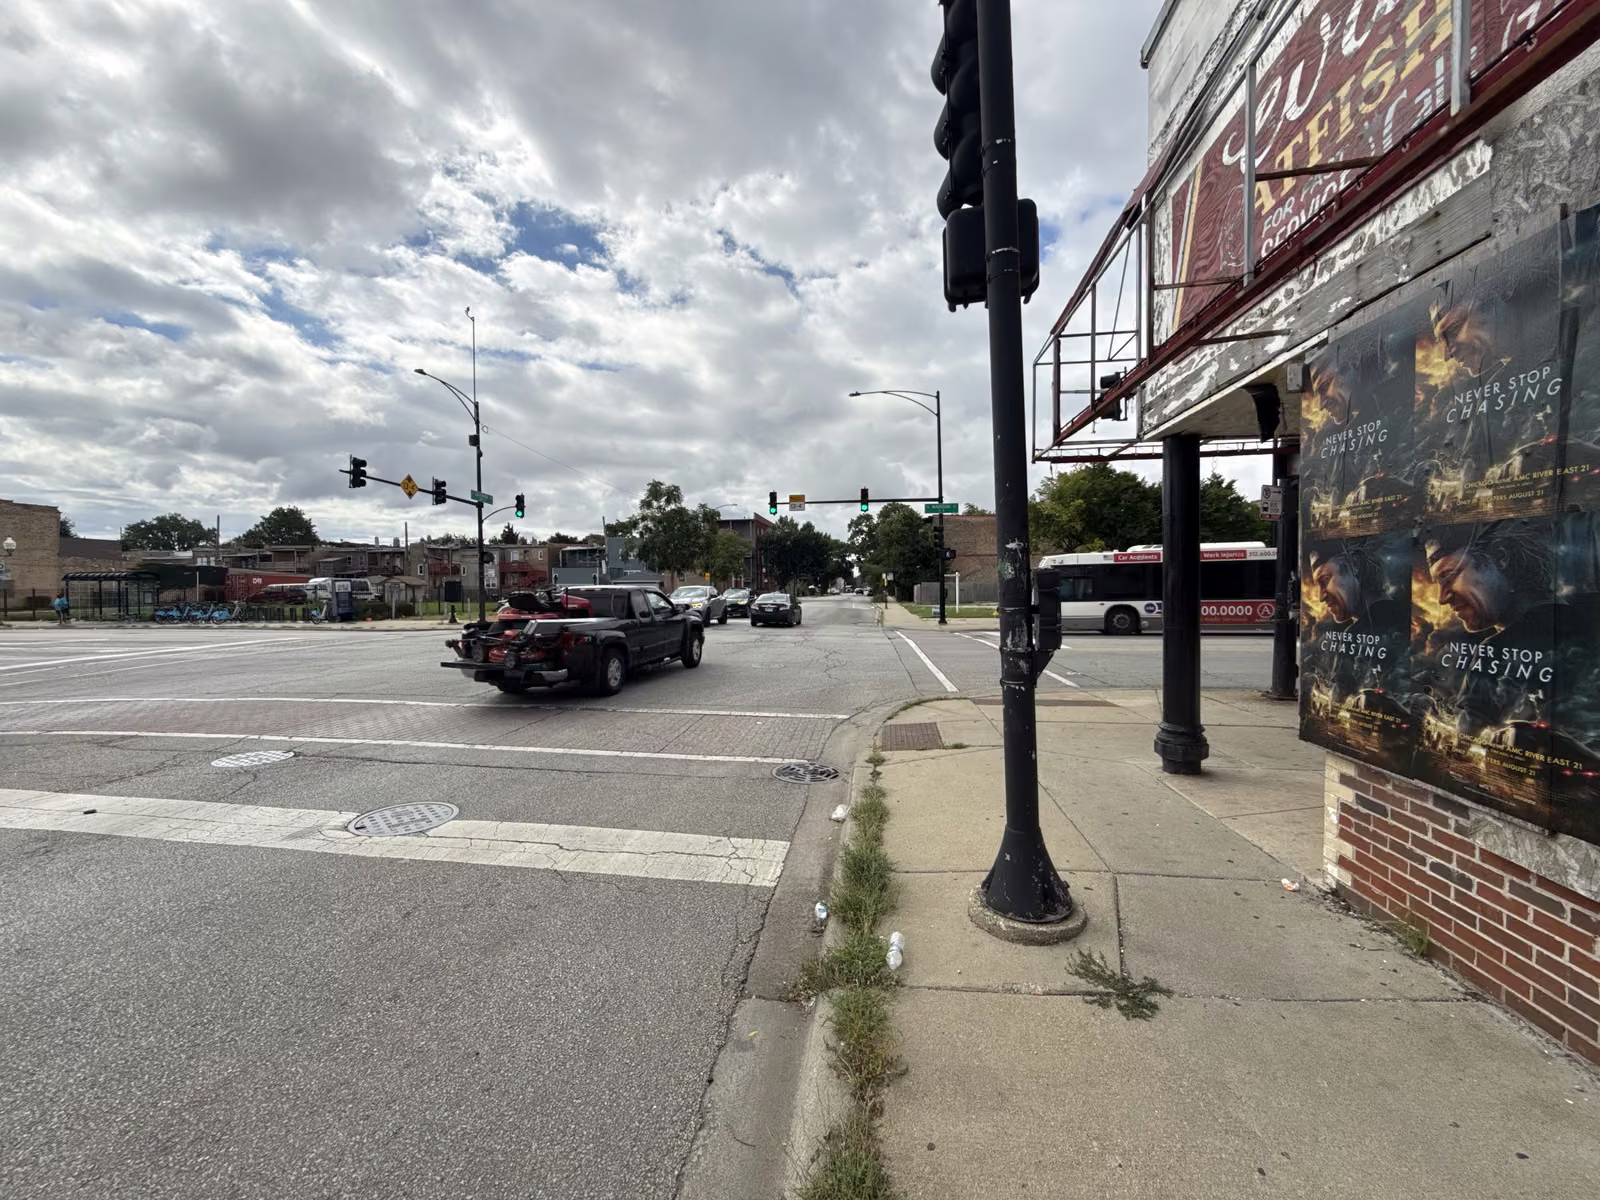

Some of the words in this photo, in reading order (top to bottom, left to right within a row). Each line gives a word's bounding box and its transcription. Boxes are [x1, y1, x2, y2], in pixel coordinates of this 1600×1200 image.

[1261, 196, 1295, 239] FOR
[1454, 382, 1500, 405] NEVER
[1508, 366, 1550, 389] STOP
[1446, 378, 1563, 423] CHASING
[1320, 429, 1388, 459] CHASING
[1325, 430, 1353, 445] NEVER
[1356, 420, 1381, 436] STOP
[1532, 468, 1554, 479] RIVER
[1556, 466, 1579, 475] EAST
[1580, 464, 1590, 472] 21
[1508, 490, 1535, 500] AUGUST
[1201, 605, 1253, 616] 00.0000
[1320, 640, 1388, 659] CHASING
[1325, 631, 1353, 642] NEVER
[1356, 634, 1380, 645] STOP
[1450, 641, 1494, 658] NEVER
[1502, 647, 1543, 664] STOP
[1441, 653, 1554, 683] CHASING
[1502, 762, 1527, 774] AUGUST
[1506, 746, 1524, 756] AMC
[1525, 750, 1545, 762] RIVER
[1547, 757, 1570, 767] EAST
[1573, 761, 1583, 770] 21
